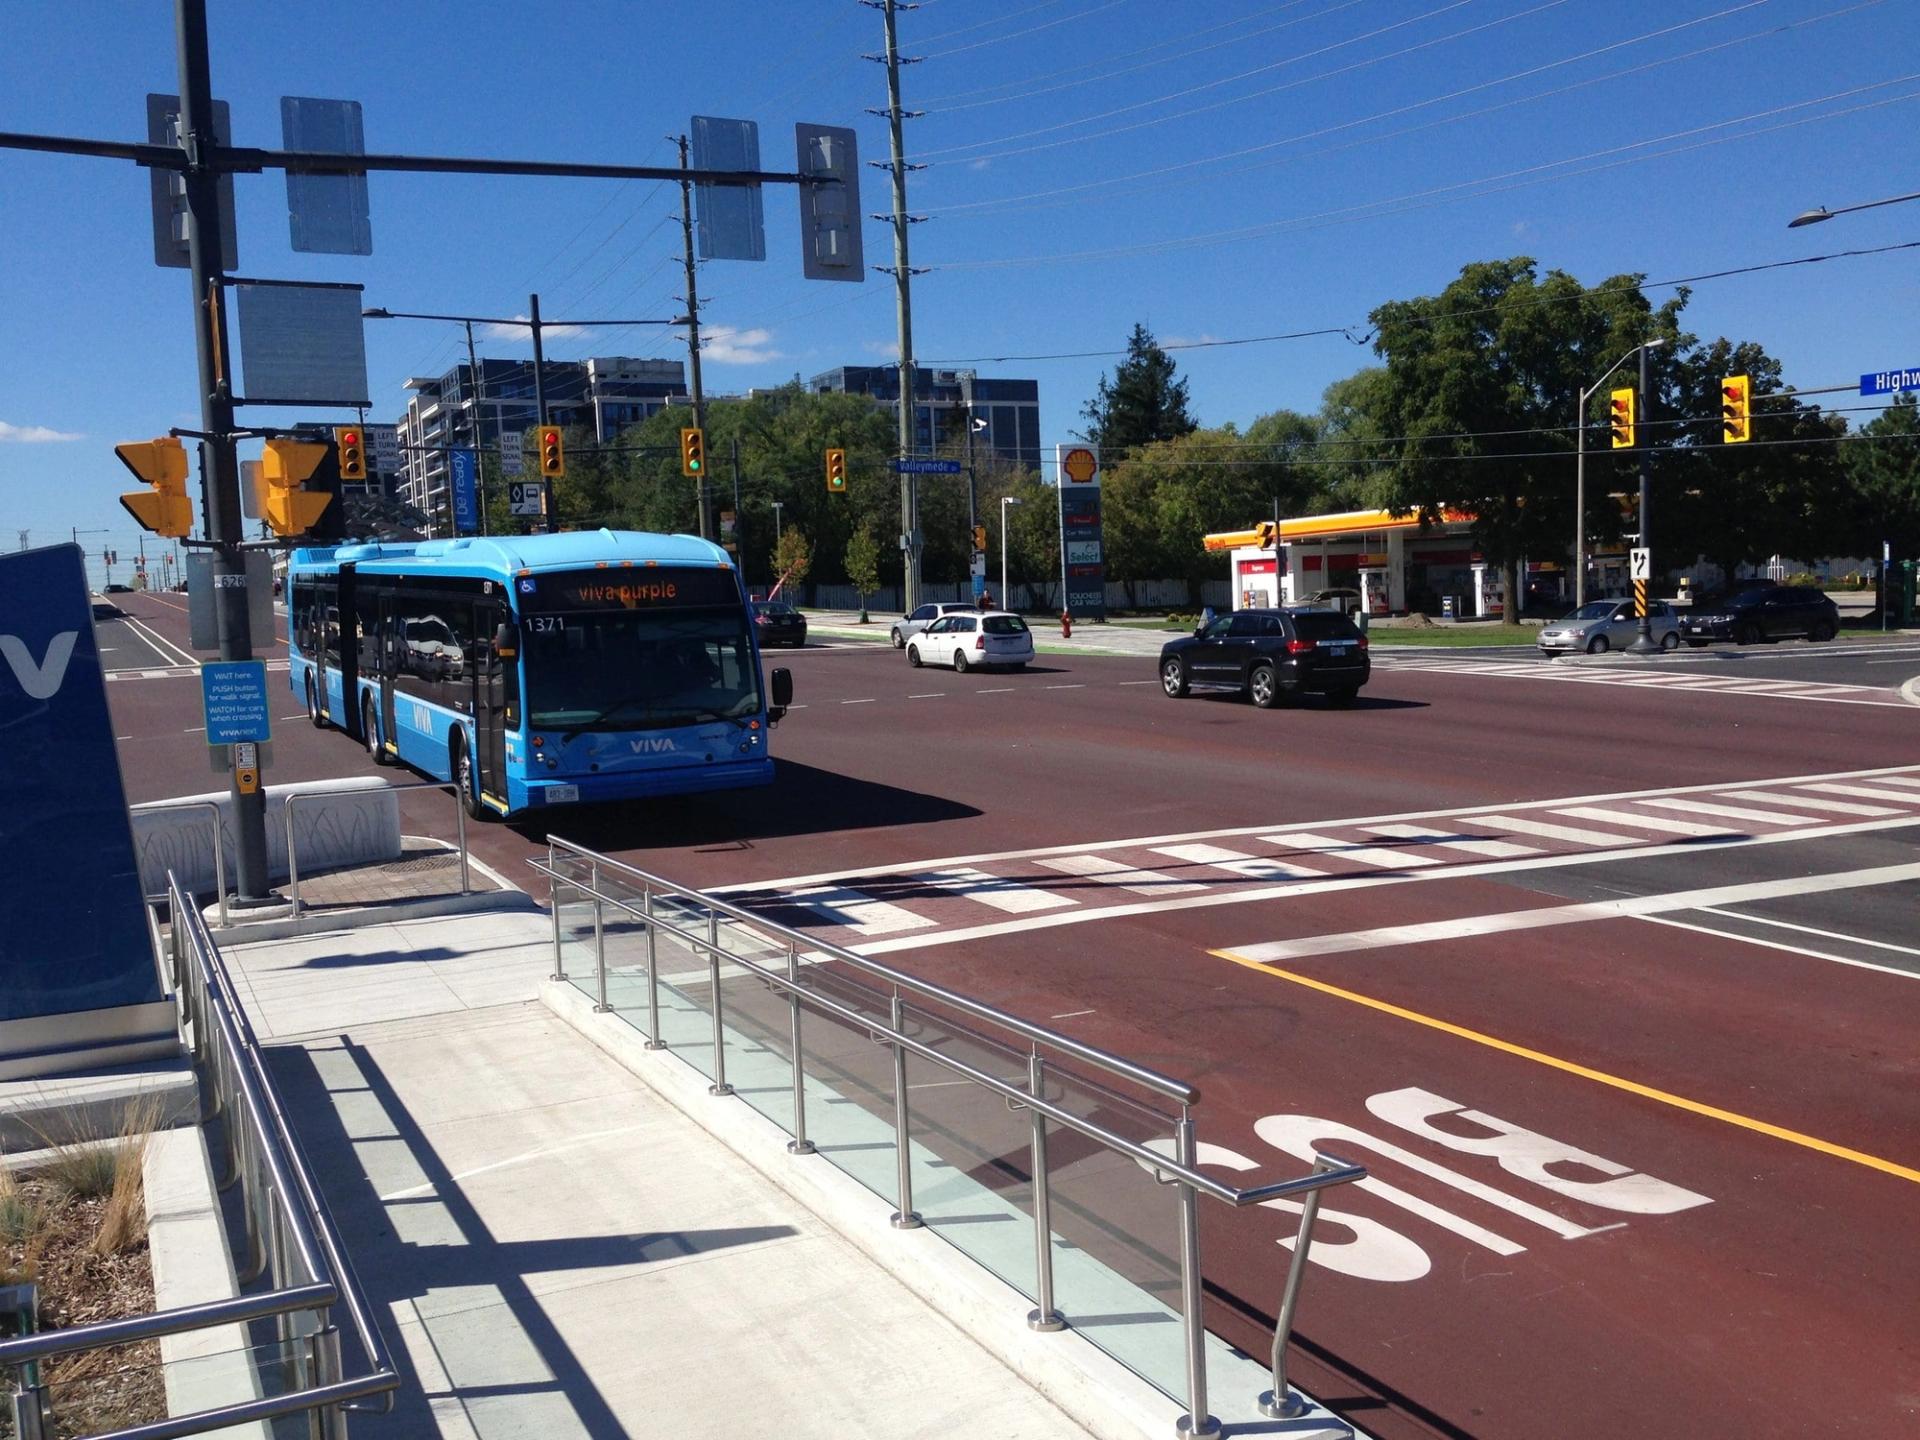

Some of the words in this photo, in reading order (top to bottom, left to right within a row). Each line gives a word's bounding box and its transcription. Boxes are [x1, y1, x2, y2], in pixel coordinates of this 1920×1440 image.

[900, 461, 948, 473] Valleymede
[456, 497, 468, 515] be
[1070, 552, 1098, 561] Select
[578, 588, 614, 600] viva
[620, 581, 677, 600] purple
[526, 617, 565, 632] 1371
[214, 672, 233, 680] WAIT
[220, 693, 238, 701] walk
[208, 705, 236, 714] WATCH
[413, 703, 433, 736] VIVA
[630, 738, 676, 753] VIVA
[1134, 1086, 1715, 1283] BUS
